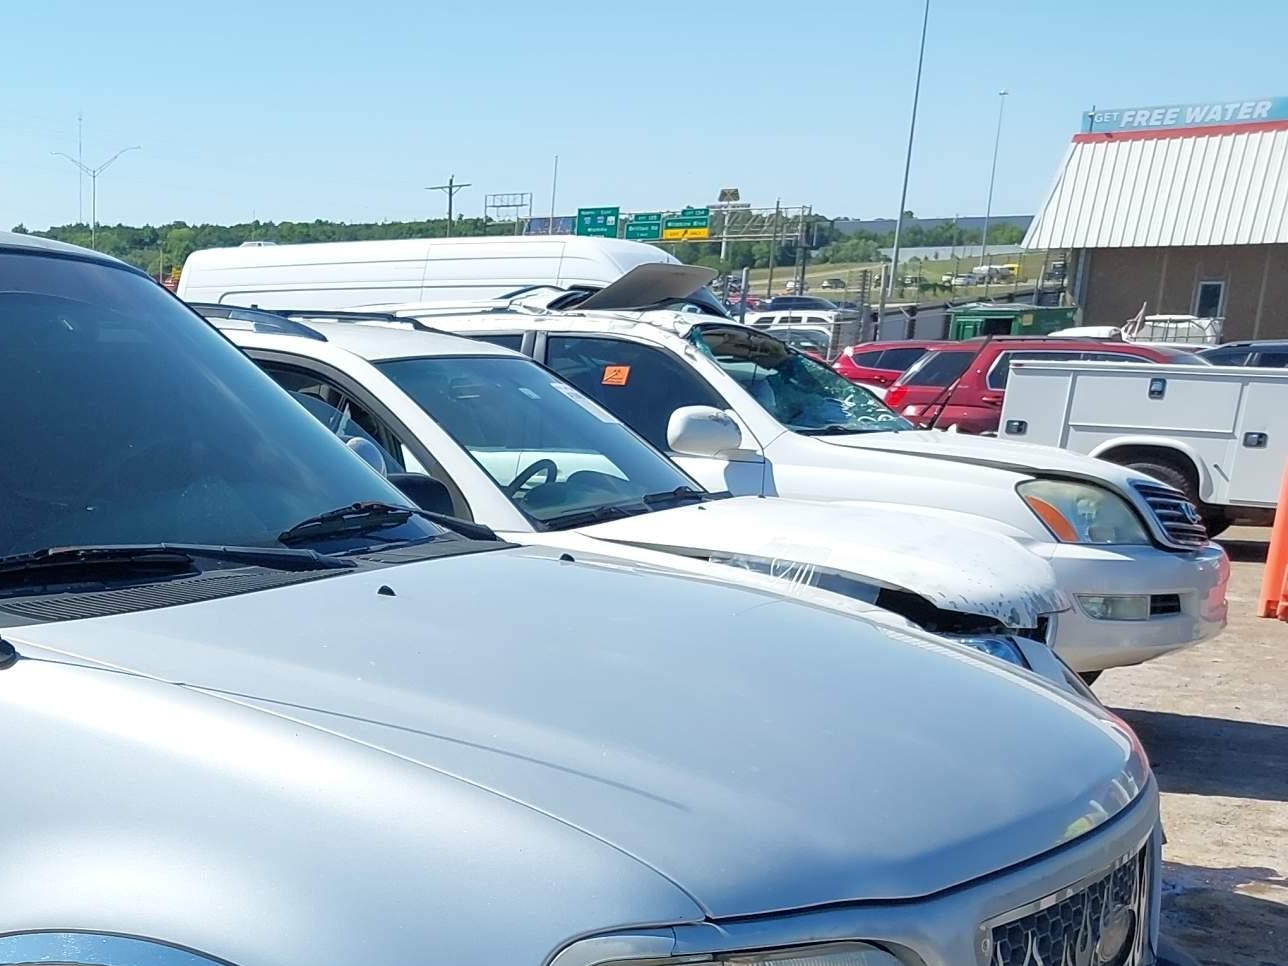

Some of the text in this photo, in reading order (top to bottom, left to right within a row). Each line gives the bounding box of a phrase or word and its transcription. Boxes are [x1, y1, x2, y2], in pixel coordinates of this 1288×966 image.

[1094, 100, 1272, 128] GET FREE WATER
